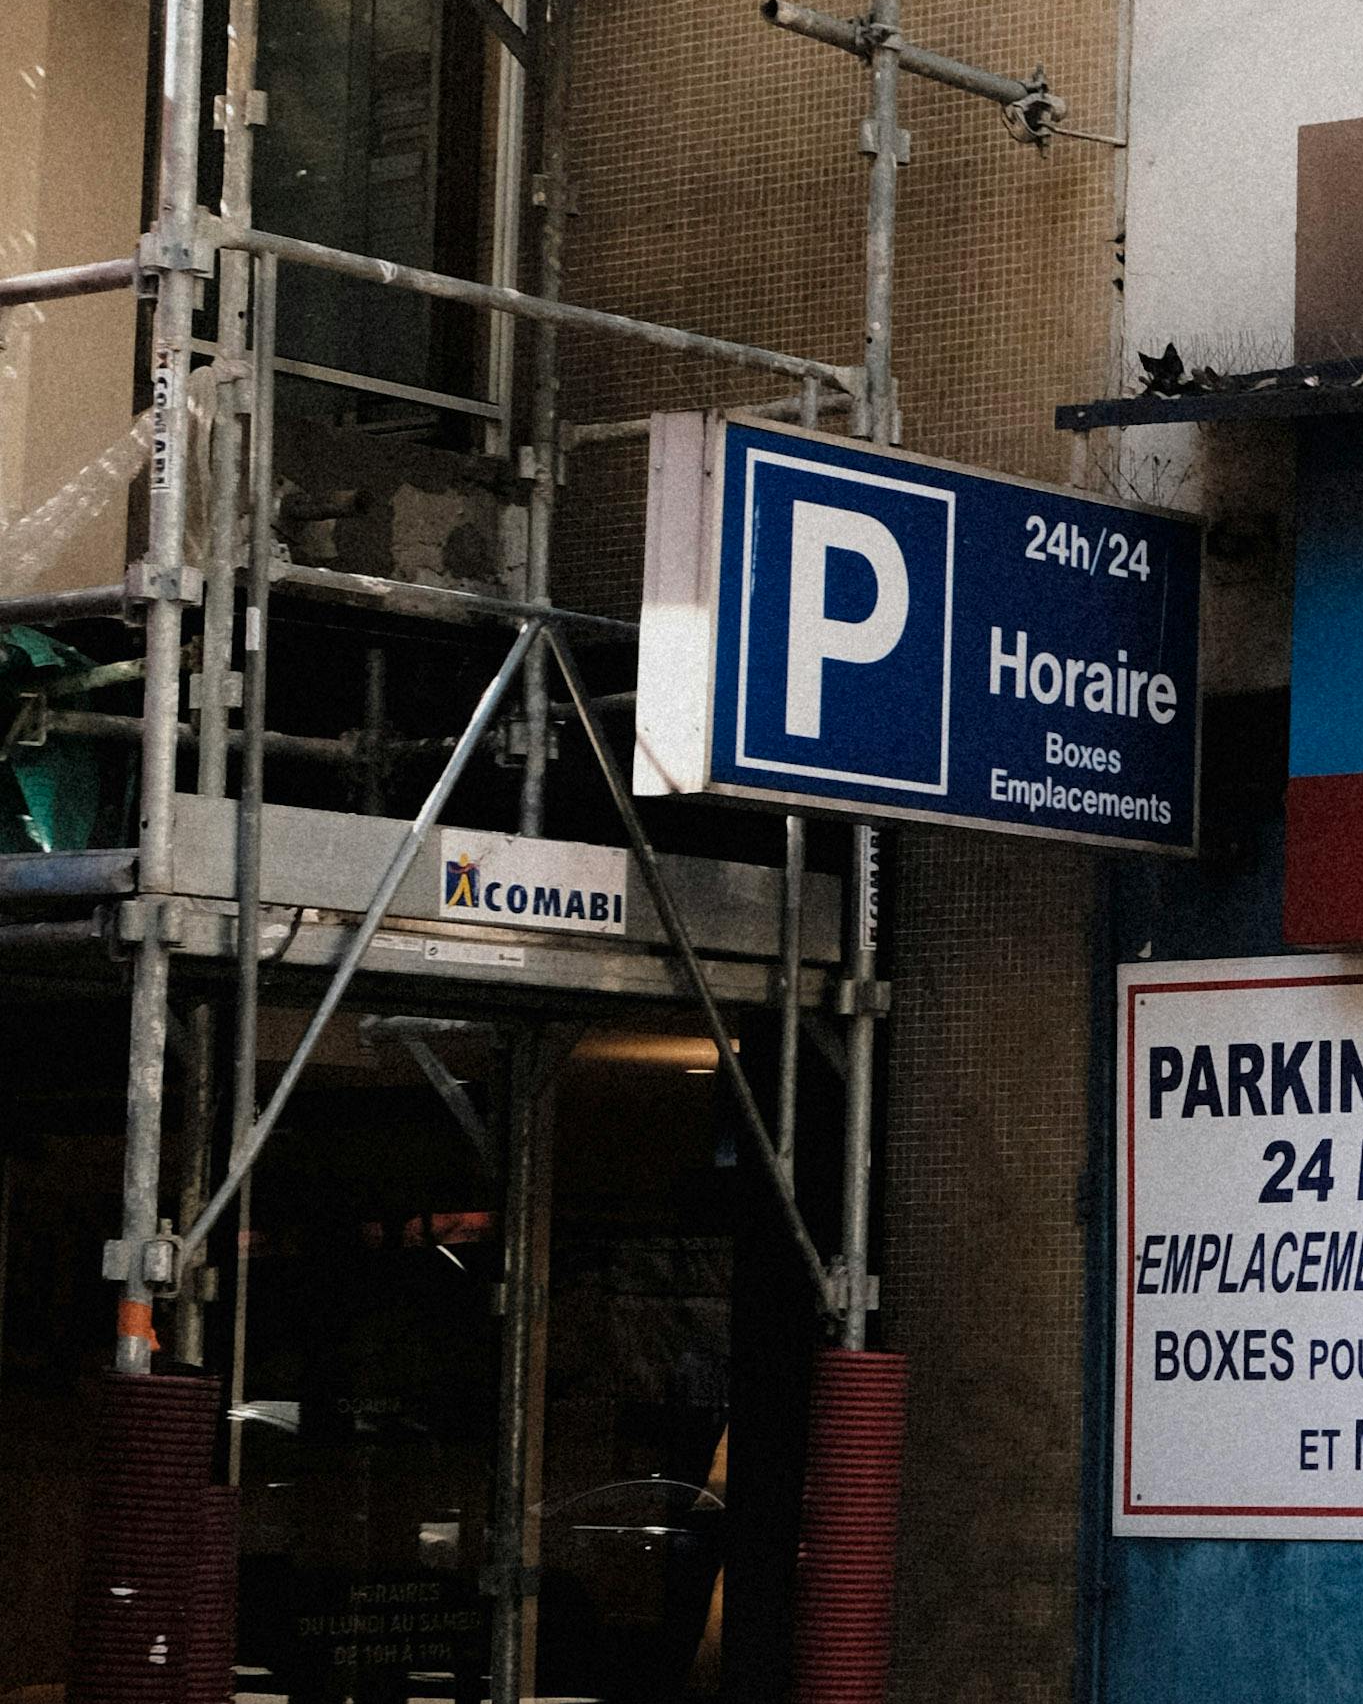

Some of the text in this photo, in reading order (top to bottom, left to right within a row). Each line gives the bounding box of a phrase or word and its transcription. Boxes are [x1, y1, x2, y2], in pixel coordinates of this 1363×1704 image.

[1024, 514, 1151, 582] 24h/24
[784, 498, 910, 741] P
[988, 625, 1179, 726] Horaire
[1045, 730, 1122, 774] Boxes
[990, 768, 1172, 825] Emplacements
[484, 880, 623, 924] COMABI
[1258, 1137, 1335, 1204] 24
[1153, 1328, 1295, 1382] BOXES
[1299, 1428, 1341, 1471] ET
